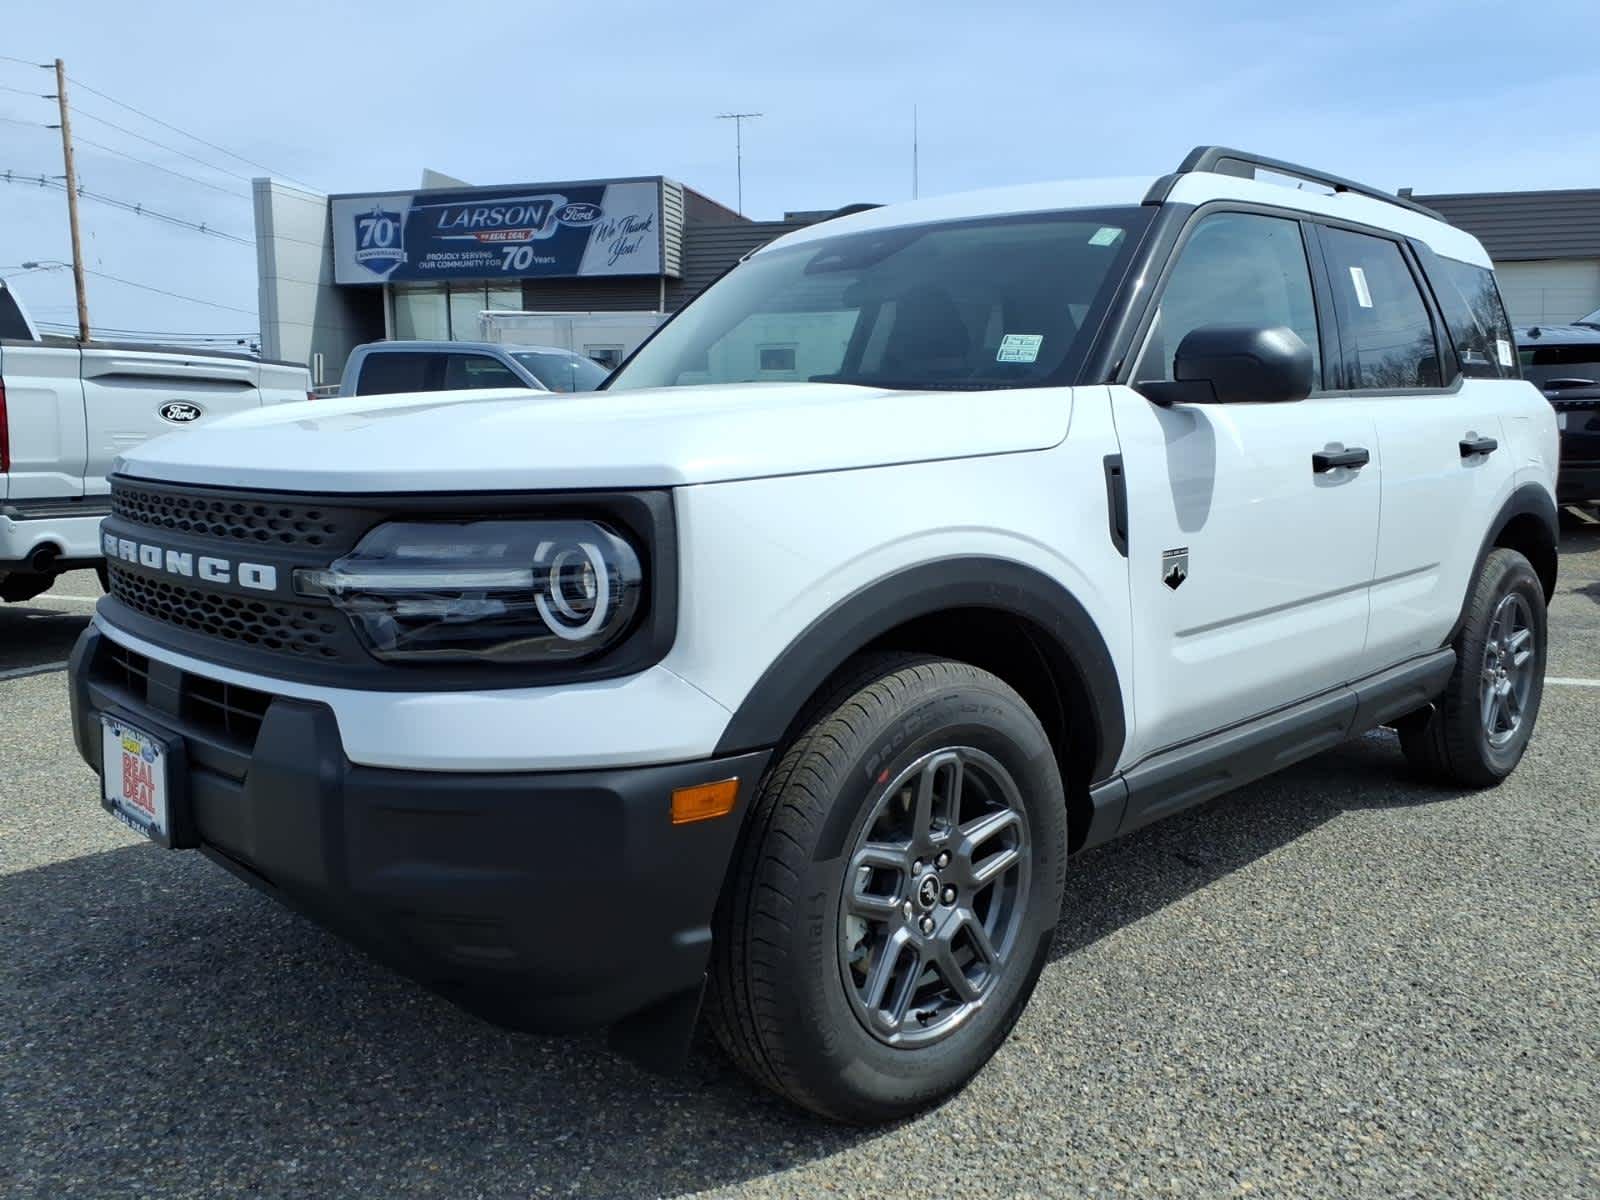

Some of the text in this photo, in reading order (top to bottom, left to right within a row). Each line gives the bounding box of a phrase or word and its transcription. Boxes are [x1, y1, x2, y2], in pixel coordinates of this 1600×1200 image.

[437, 205, 545, 229] LARSON
[562, 206, 595, 221] Ford
[618, 213, 654, 240] Thank
[418, 259, 502, 269] OUR COMMUNITY FOR
[502, 245, 534, 271] 70
[608, 236, 644, 267] You!
[167, 404, 197, 421] Ford
[122, 752, 155, 791] REAL
[122, 775, 156, 816] DEAL
